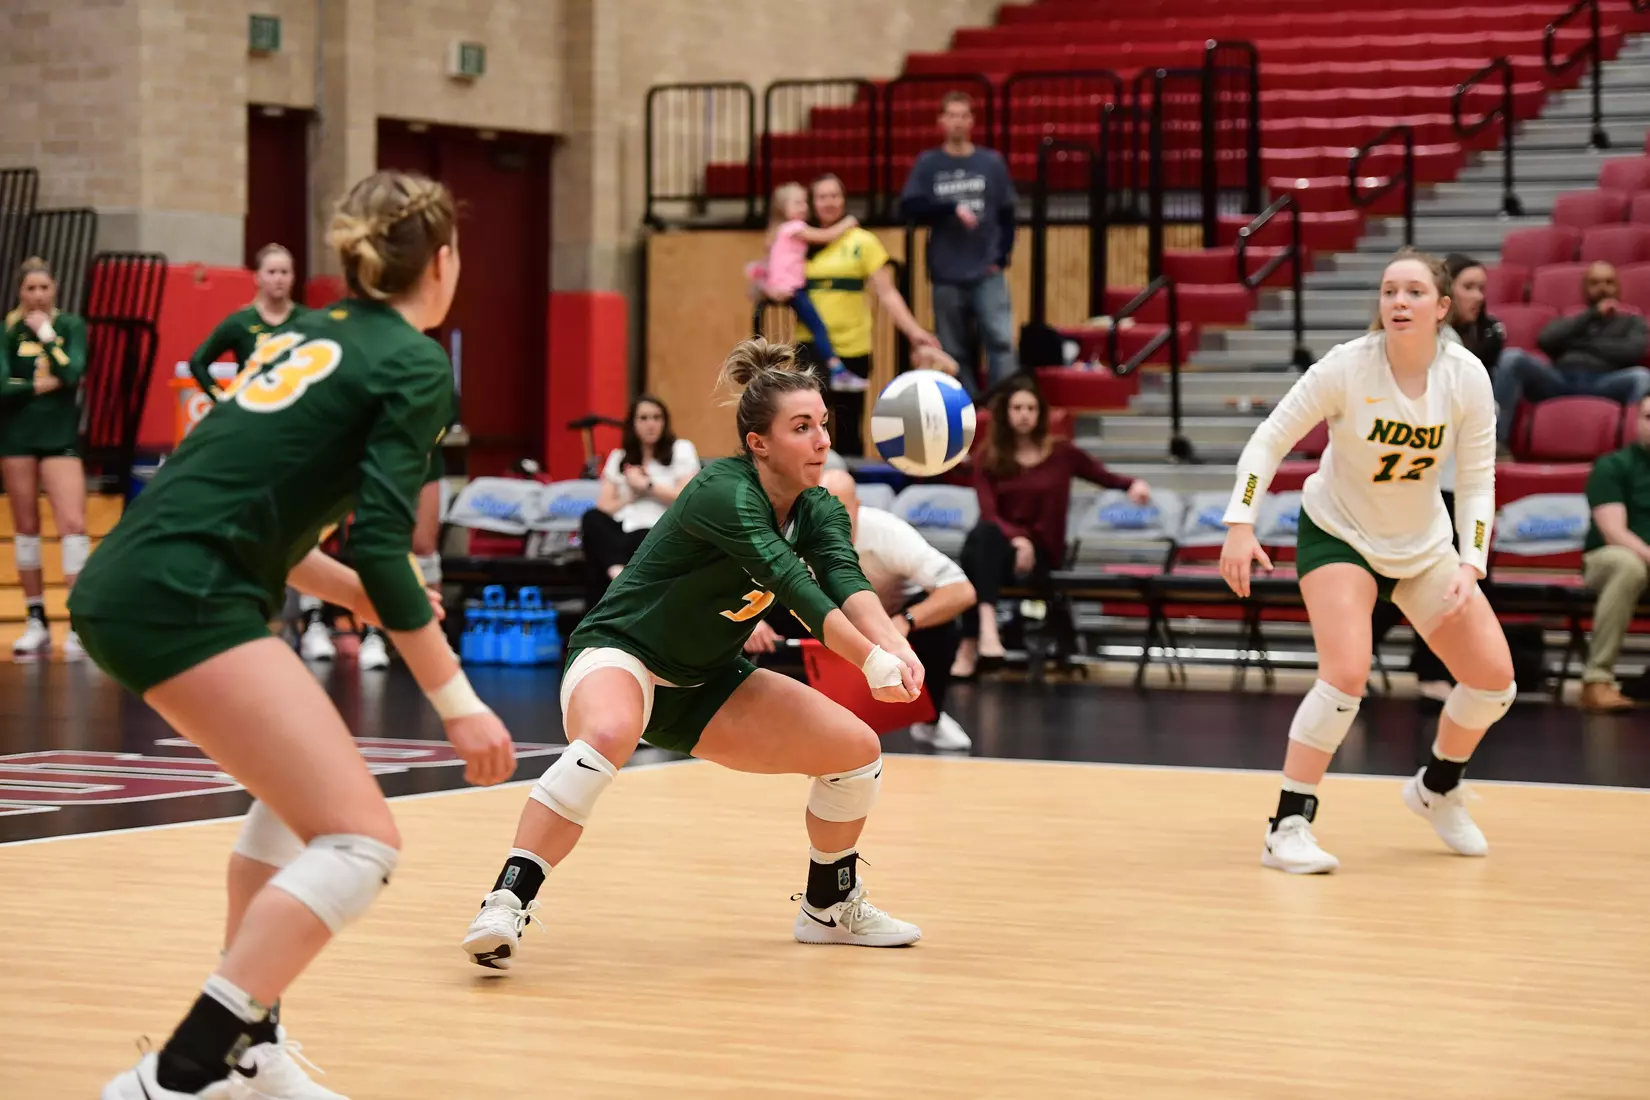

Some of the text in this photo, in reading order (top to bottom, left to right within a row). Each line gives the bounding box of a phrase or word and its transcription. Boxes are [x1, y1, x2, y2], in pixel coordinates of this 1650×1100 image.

[1367, 417, 1447, 450] NDSU
[1373, 453, 1436, 483] 12
[1241, 472, 1259, 507] BISON
